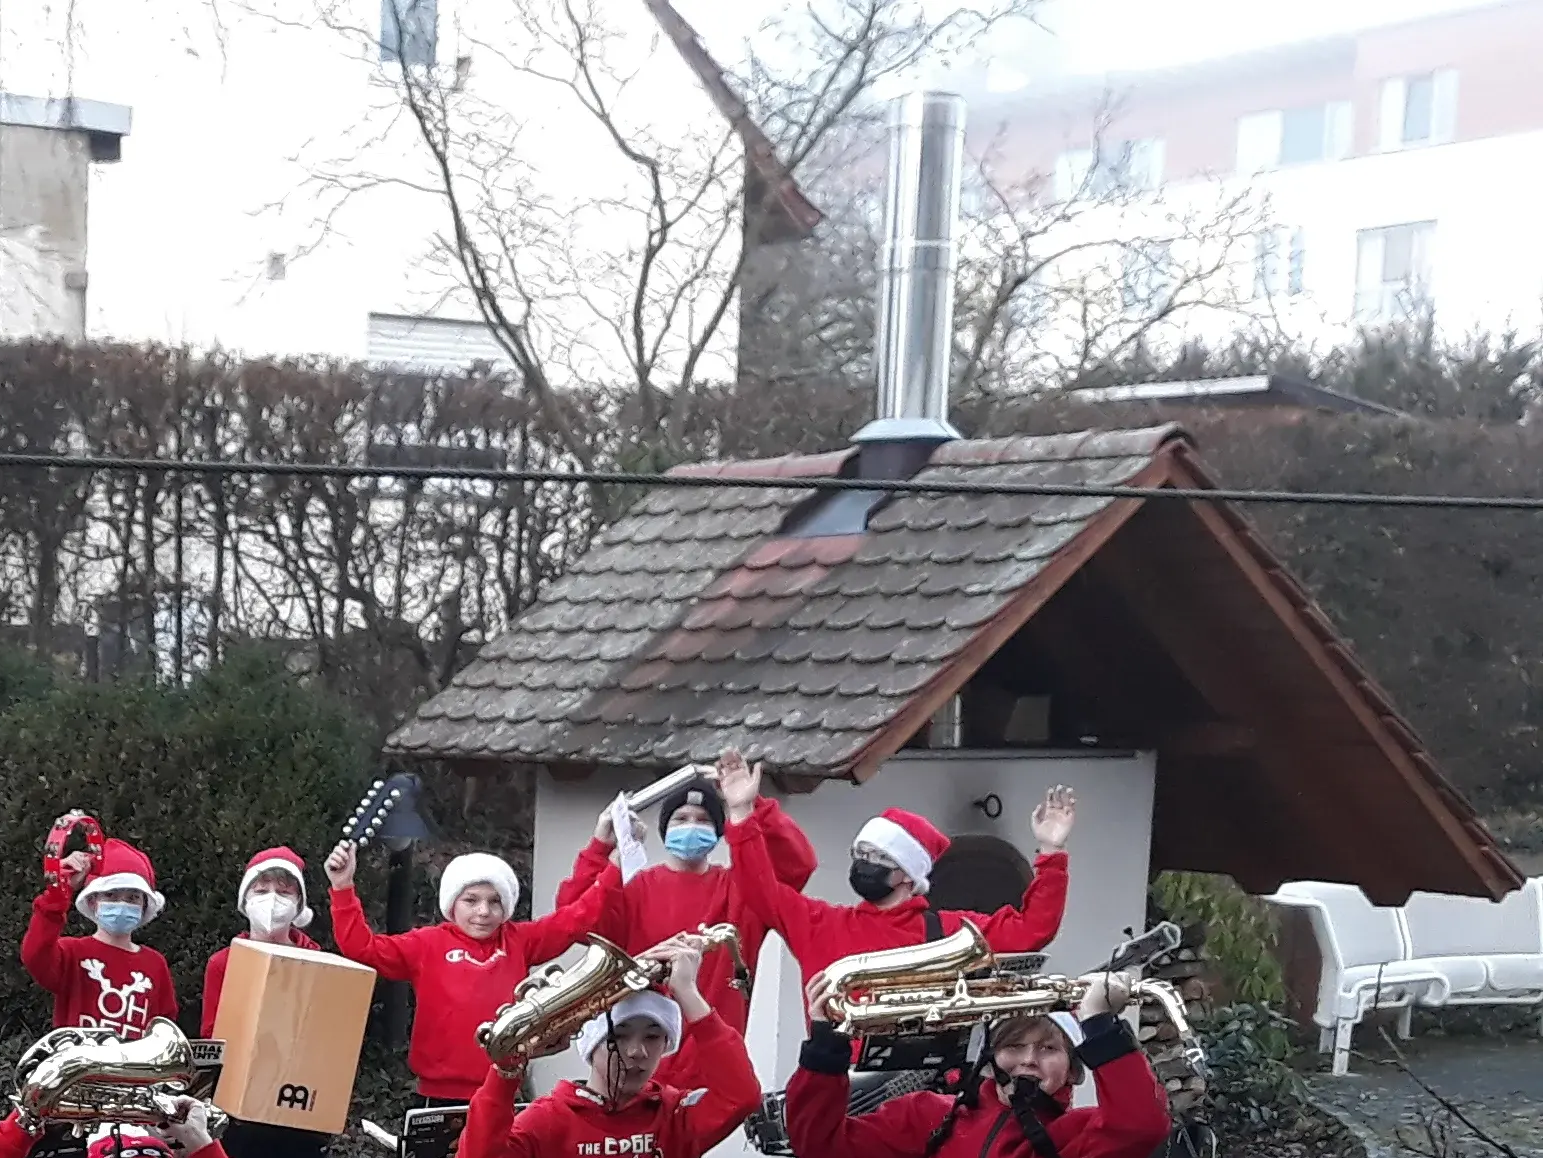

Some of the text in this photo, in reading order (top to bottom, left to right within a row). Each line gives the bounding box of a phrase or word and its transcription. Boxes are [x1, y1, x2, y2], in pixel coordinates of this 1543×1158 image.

[98, 987, 149, 1026] OH
[577, 1133, 655, 1156] THE EDGE
